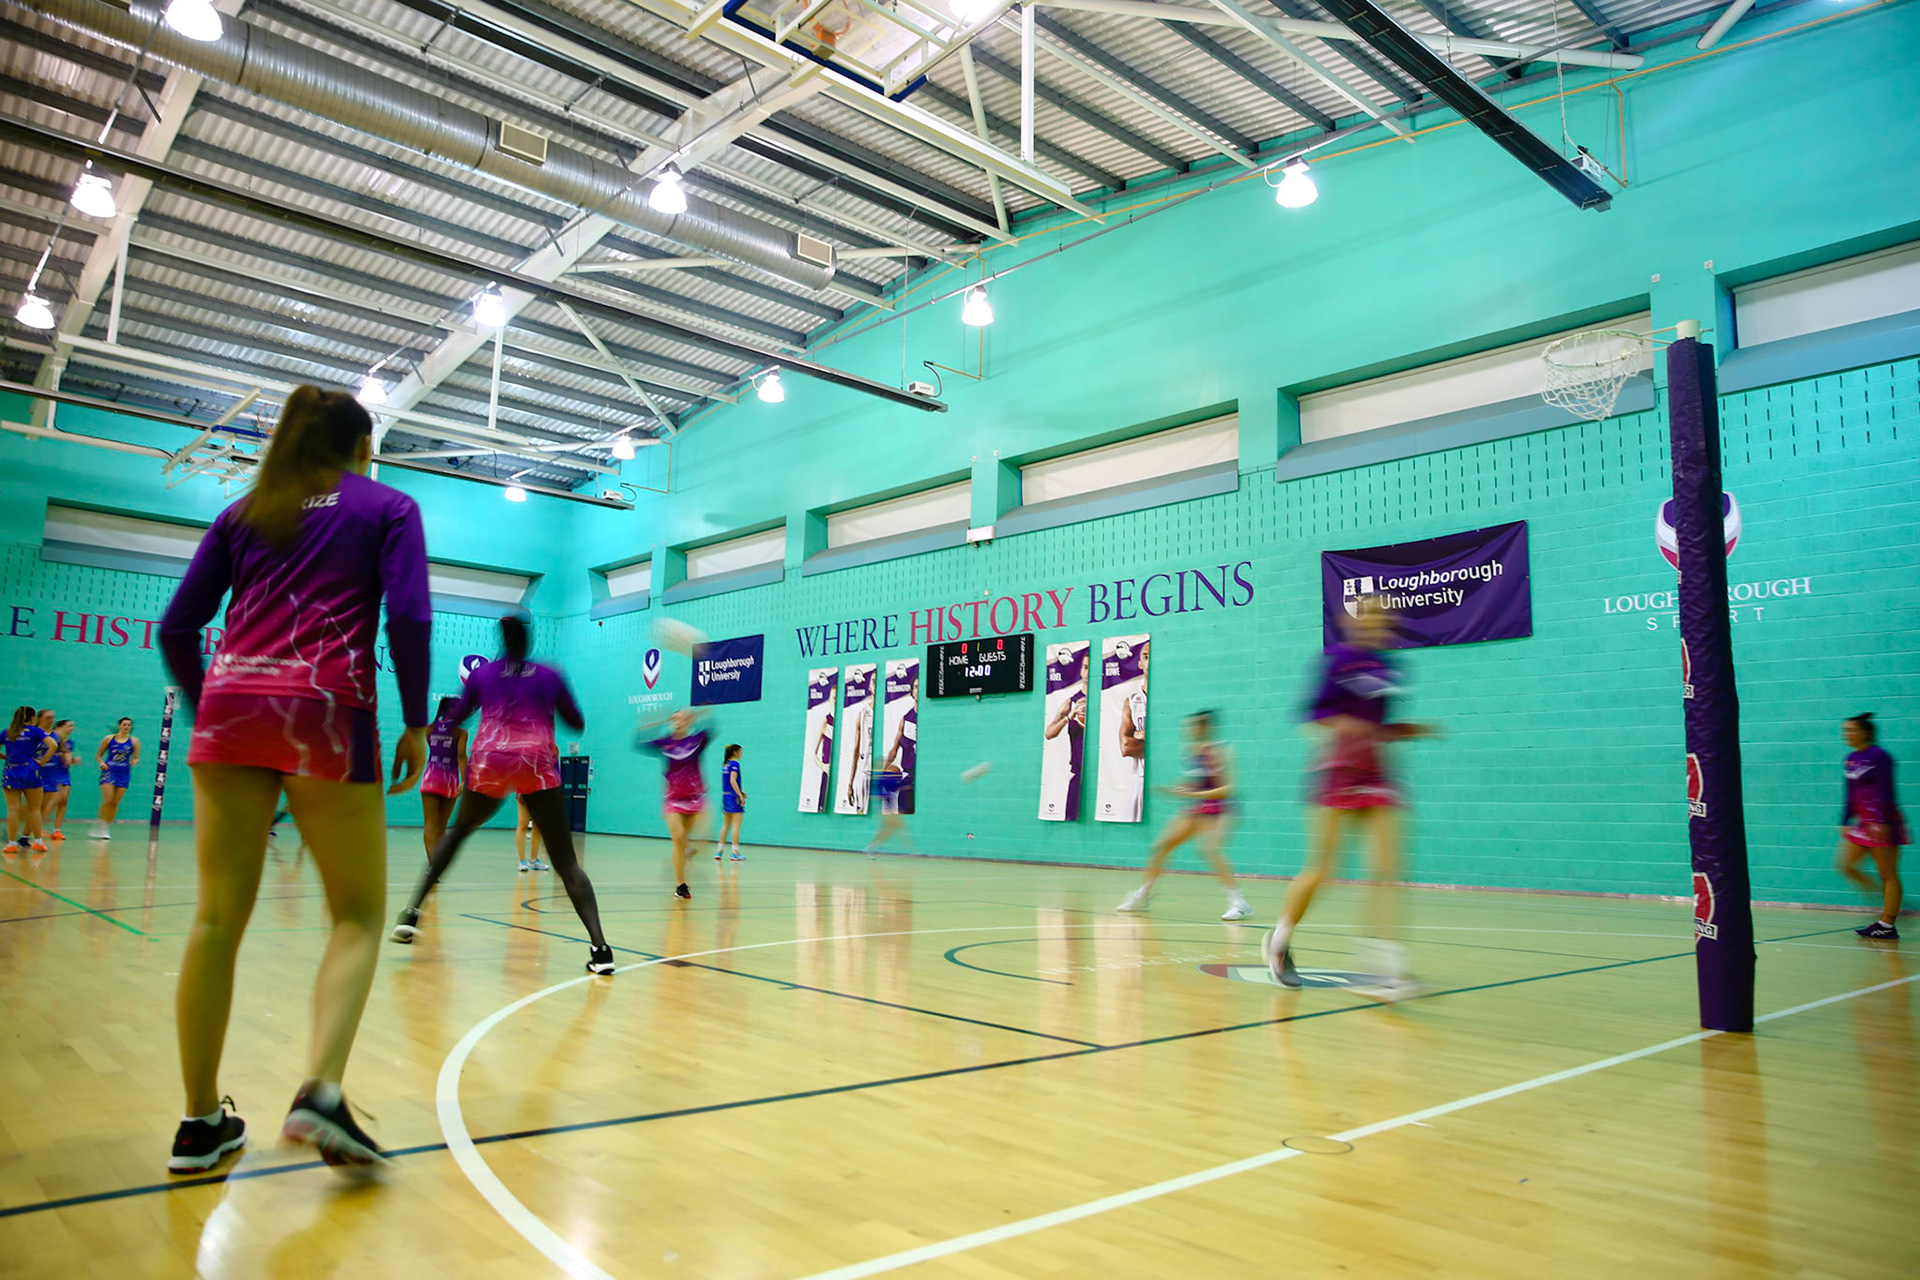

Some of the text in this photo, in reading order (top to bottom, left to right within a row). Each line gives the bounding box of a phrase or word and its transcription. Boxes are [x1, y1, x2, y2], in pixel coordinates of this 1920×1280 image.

[1378, 559, 1503, 591] Loughborough
[1379, 588, 1464, 610] University
[1604, 577, 1812, 614] LOUGHOUGH
[795, 561, 1254, 659] WHERE HISTORY BEGINS
[50, 609, 226, 656] HISTR
[961, 643, 968, 654] 0
[997, 638, 1004, 650] 0
[711, 655, 755, 671] Loughborough
[948, 651, 1007, 666] HOME GUESTS
[711, 670, 741, 682] University
